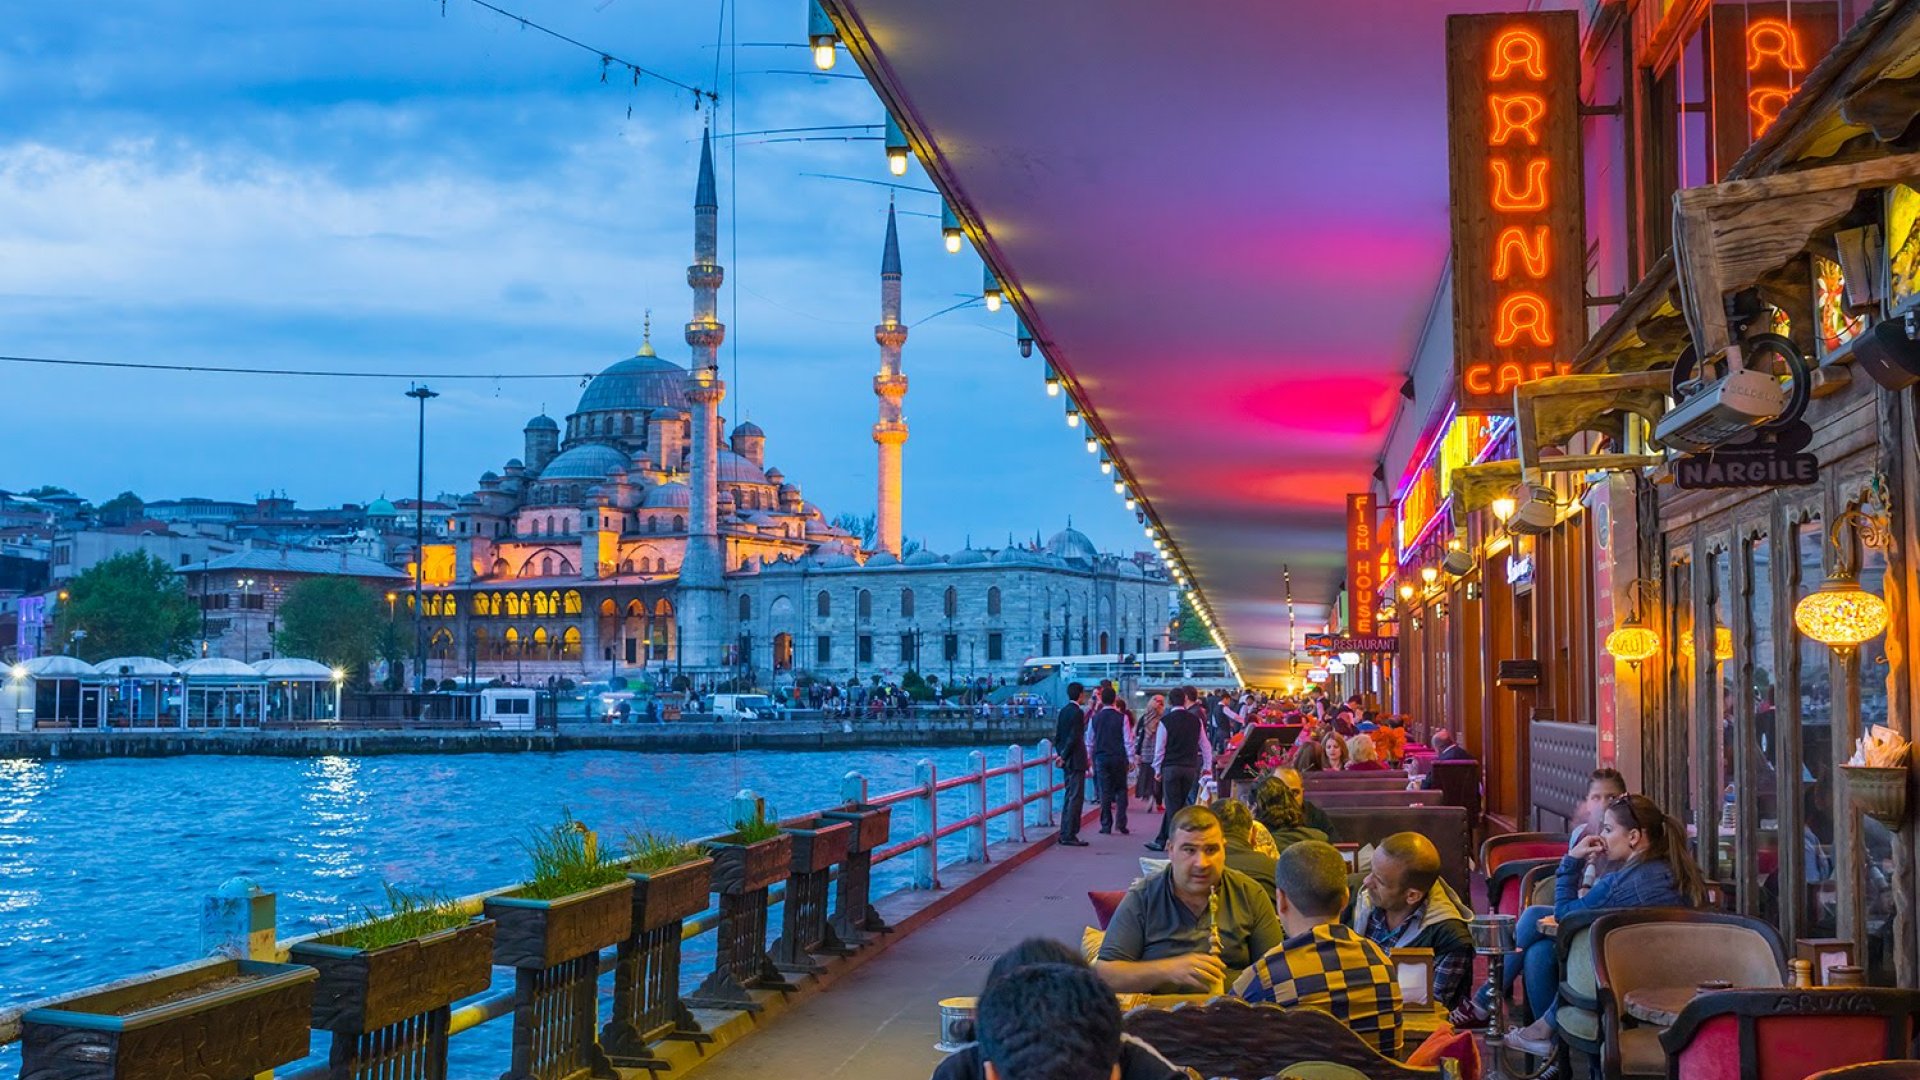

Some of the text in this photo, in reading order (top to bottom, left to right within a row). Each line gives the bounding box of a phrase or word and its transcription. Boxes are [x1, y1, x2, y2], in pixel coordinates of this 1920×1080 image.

[1490, 29, 1551, 347] ARUNA
[1683, 455, 1812, 483] NARGİLE
[1355, 496, 1372, 633] FISH HOUSE
[1333, 639, 1395, 650] RESTAURANT
[1772, 993, 1876, 1012] ARUNA
